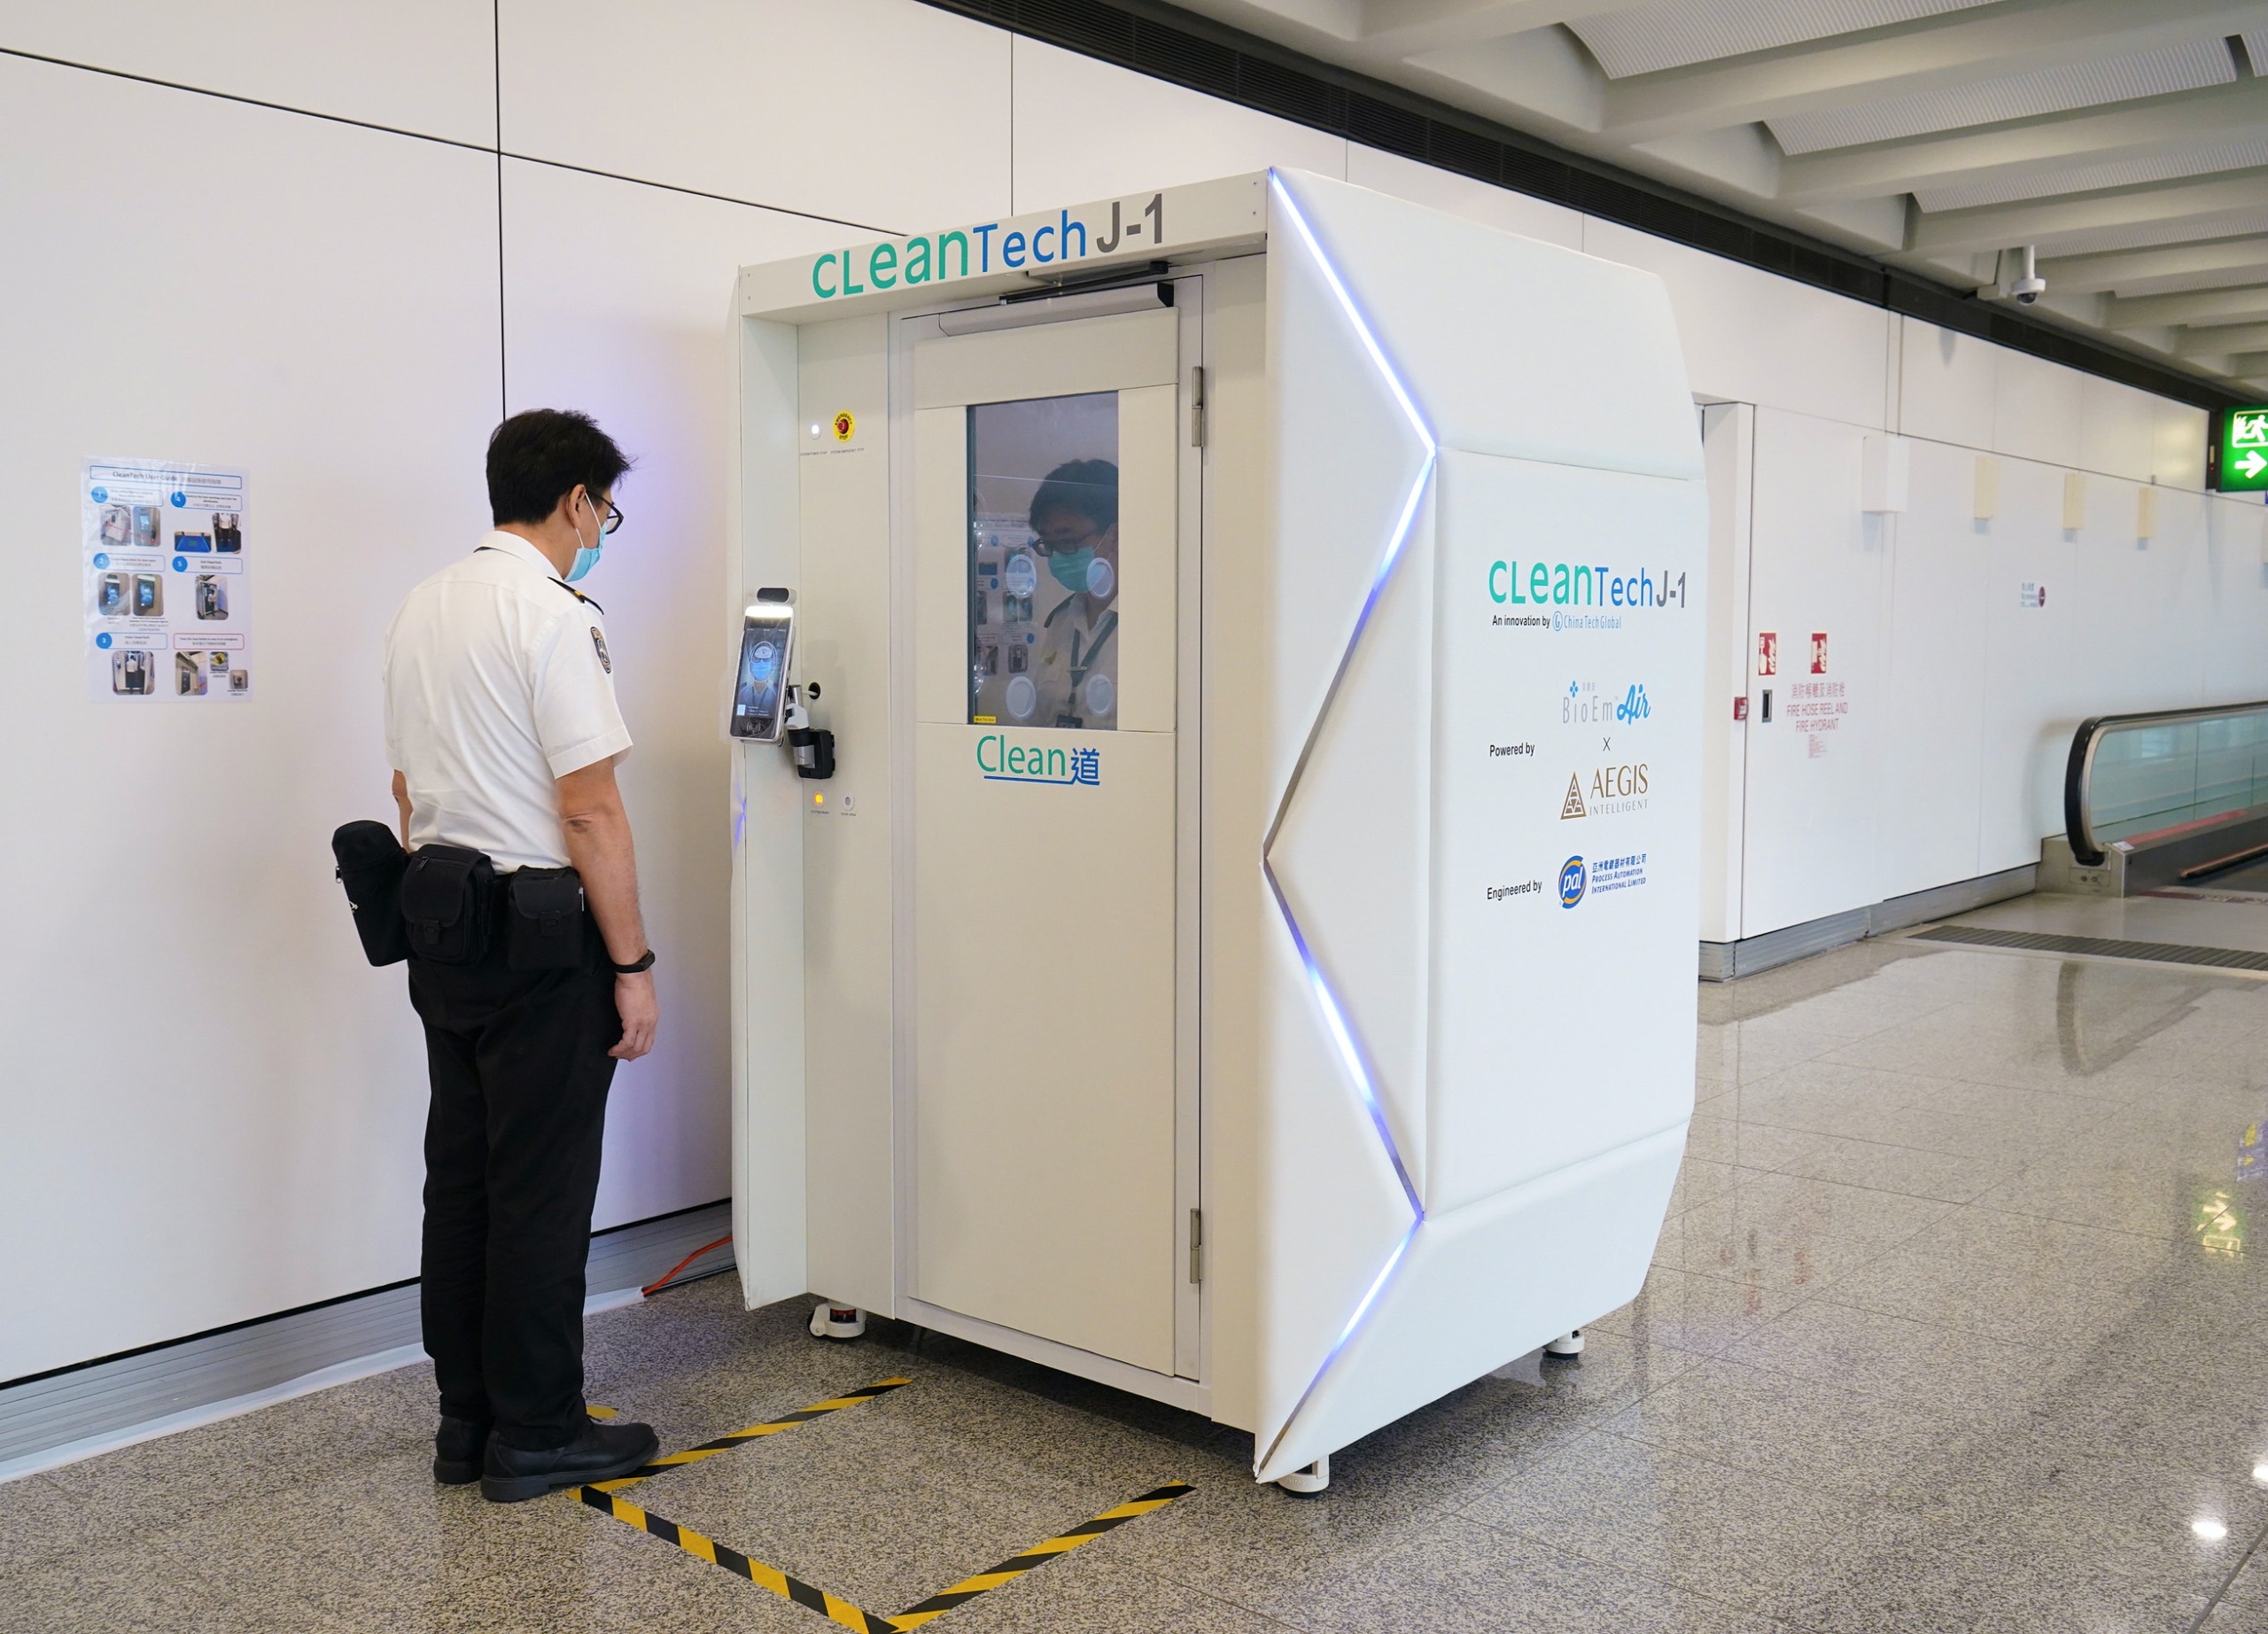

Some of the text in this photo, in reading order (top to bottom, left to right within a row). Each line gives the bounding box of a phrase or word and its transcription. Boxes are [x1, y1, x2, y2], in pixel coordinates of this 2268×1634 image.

[1096, 193, 1163, 253] J-1
[113, 471, 144, 479] CleanTech
[1656, 570, 1686, 609] J-1
[1492, 615, 1503, 626] An
[1503, 615, 1541, 626] innovation
[1542, 615, 1551, 629] by
[1616, 683, 1651, 725] Air
[1786, 702, 1849, 718] FIRE HOSE REEL AND
[1796, 718, 1839, 733] FIRE HYDRANT
[1489, 742, 1535, 758] Powered by
[1589, 763, 1649, 799] AEGIS
[1589, 799, 1649, 816] INTELLIGENT
[1487, 879, 1543, 901] Engineered by
